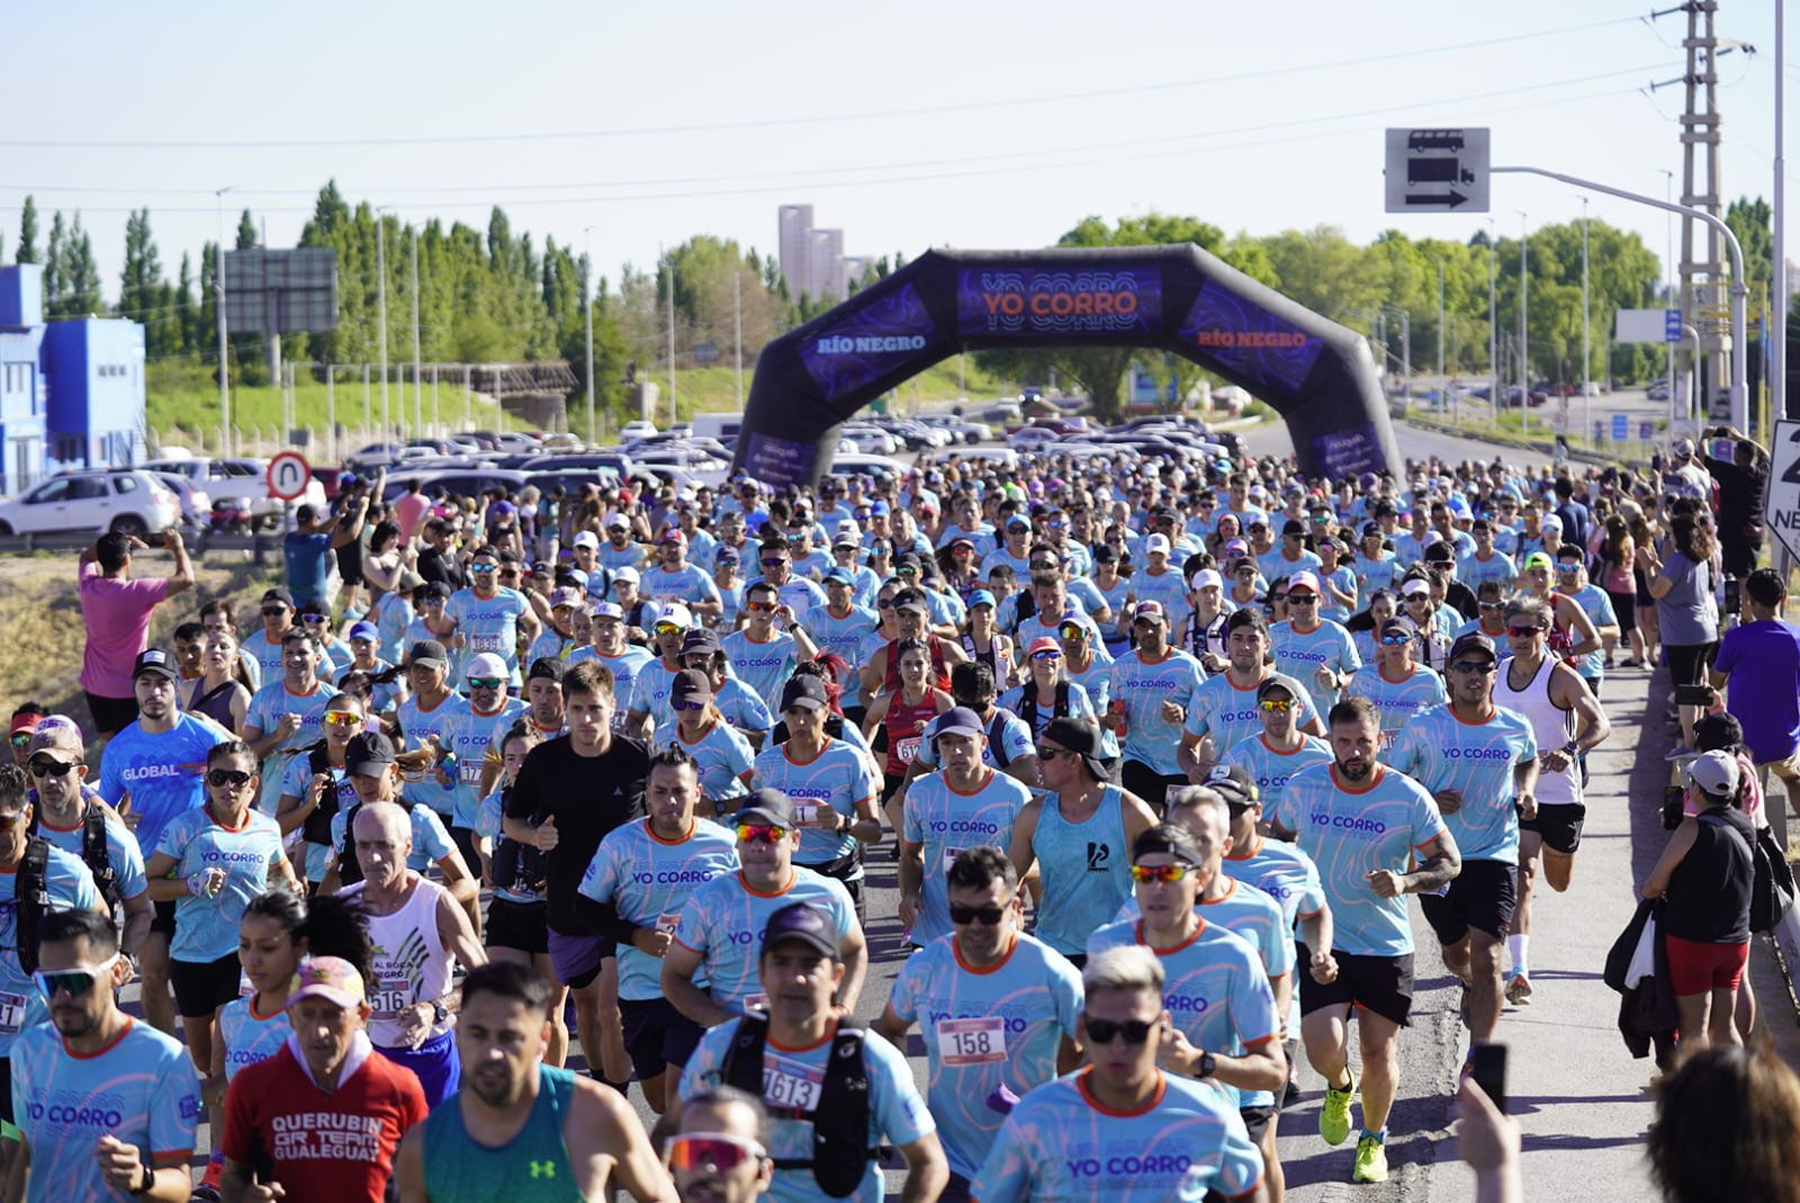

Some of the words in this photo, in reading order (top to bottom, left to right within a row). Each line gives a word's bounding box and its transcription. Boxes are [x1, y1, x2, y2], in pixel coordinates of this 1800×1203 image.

[982, 291, 1024, 316] YO
[1030, 290, 1138, 316] CORRO
[817, 334, 854, 354] RÍO
[855, 335, 926, 353] NEGRO
[1237, 331, 1306, 348] NEGRO
[829, 636, 860, 644] CORRO
[734, 658, 748, 667] YO
[748, 658, 782, 667] CORRO
[1290, 651, 1327, 663] CORRO
[1140, 680, 1176, 689] CORRO
[1384, 700, 1419, 709] CORRO
[1220, 712, 1235, 723] YO
[1442, 748, 1460, 759] YO
[1463, 748, 1511, 760] CORRO
[123, 764, 180, 781] GLOBAL
[789, 788, 831, 799] CORRO
[929, 820, 947, 833] YO
[950, 821, 998, 835] CORRO
[1310, 812, 1330, 826] YO
[1333, 815, 1386, 834] CORRO
[201, 851, 219, 862] YO
[222, 852, 264, 864] CORRO
[632, 872, 653, 885] YO
[656, 870, 712, 885] CORRO
[728, 931, 753, 945] YO
[951, 1031, 991, 1055] 158
[26, 1102, 44, 1120] YO
[47, 1105, 122, 1128] CORRO
[272, 1112, 382, 1133] QUERUBIN
[274, 1143, 379, 1162] GUALEGUAY
[1066, 1158, 1100, 1178] YO
[1107, 1154, 1192, 1175] CORRO
